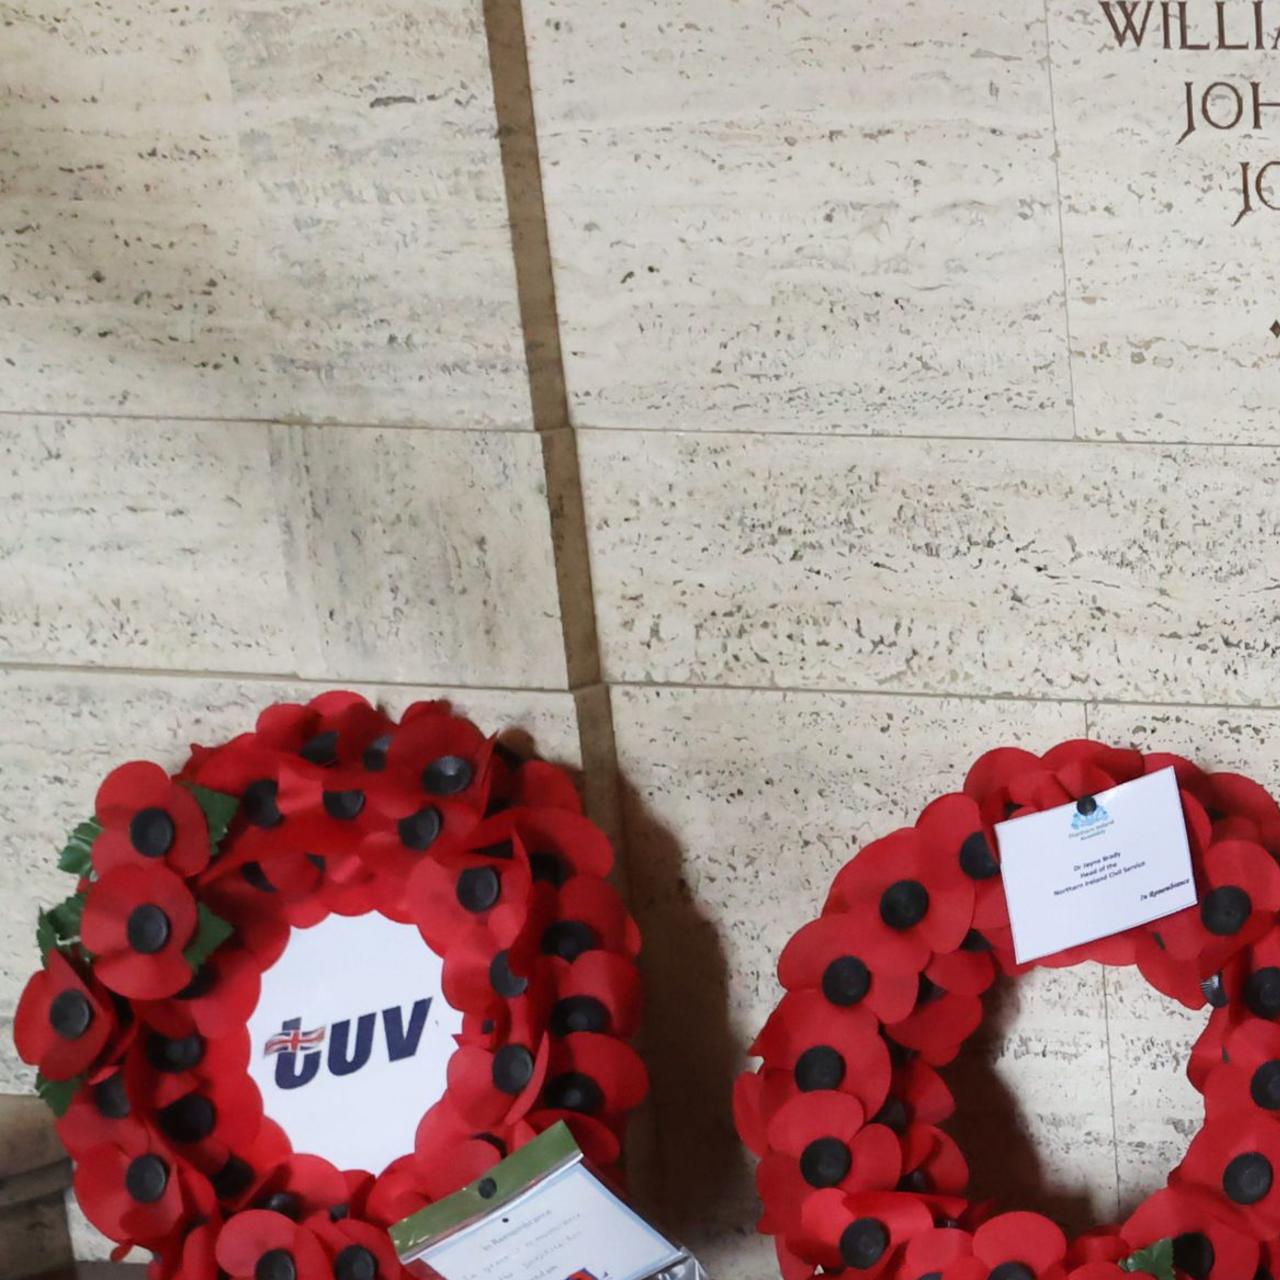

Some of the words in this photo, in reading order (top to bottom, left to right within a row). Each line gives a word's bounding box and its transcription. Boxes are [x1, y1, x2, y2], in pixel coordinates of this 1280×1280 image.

[1053, 883, 1083, 896] Northern
[1085, 874, 1107, 886] Ireland
[1123, 860, 1146, 873] Service
[1080, 869, 1097, 879] Head
[1106, 862, 1118, 870] the
